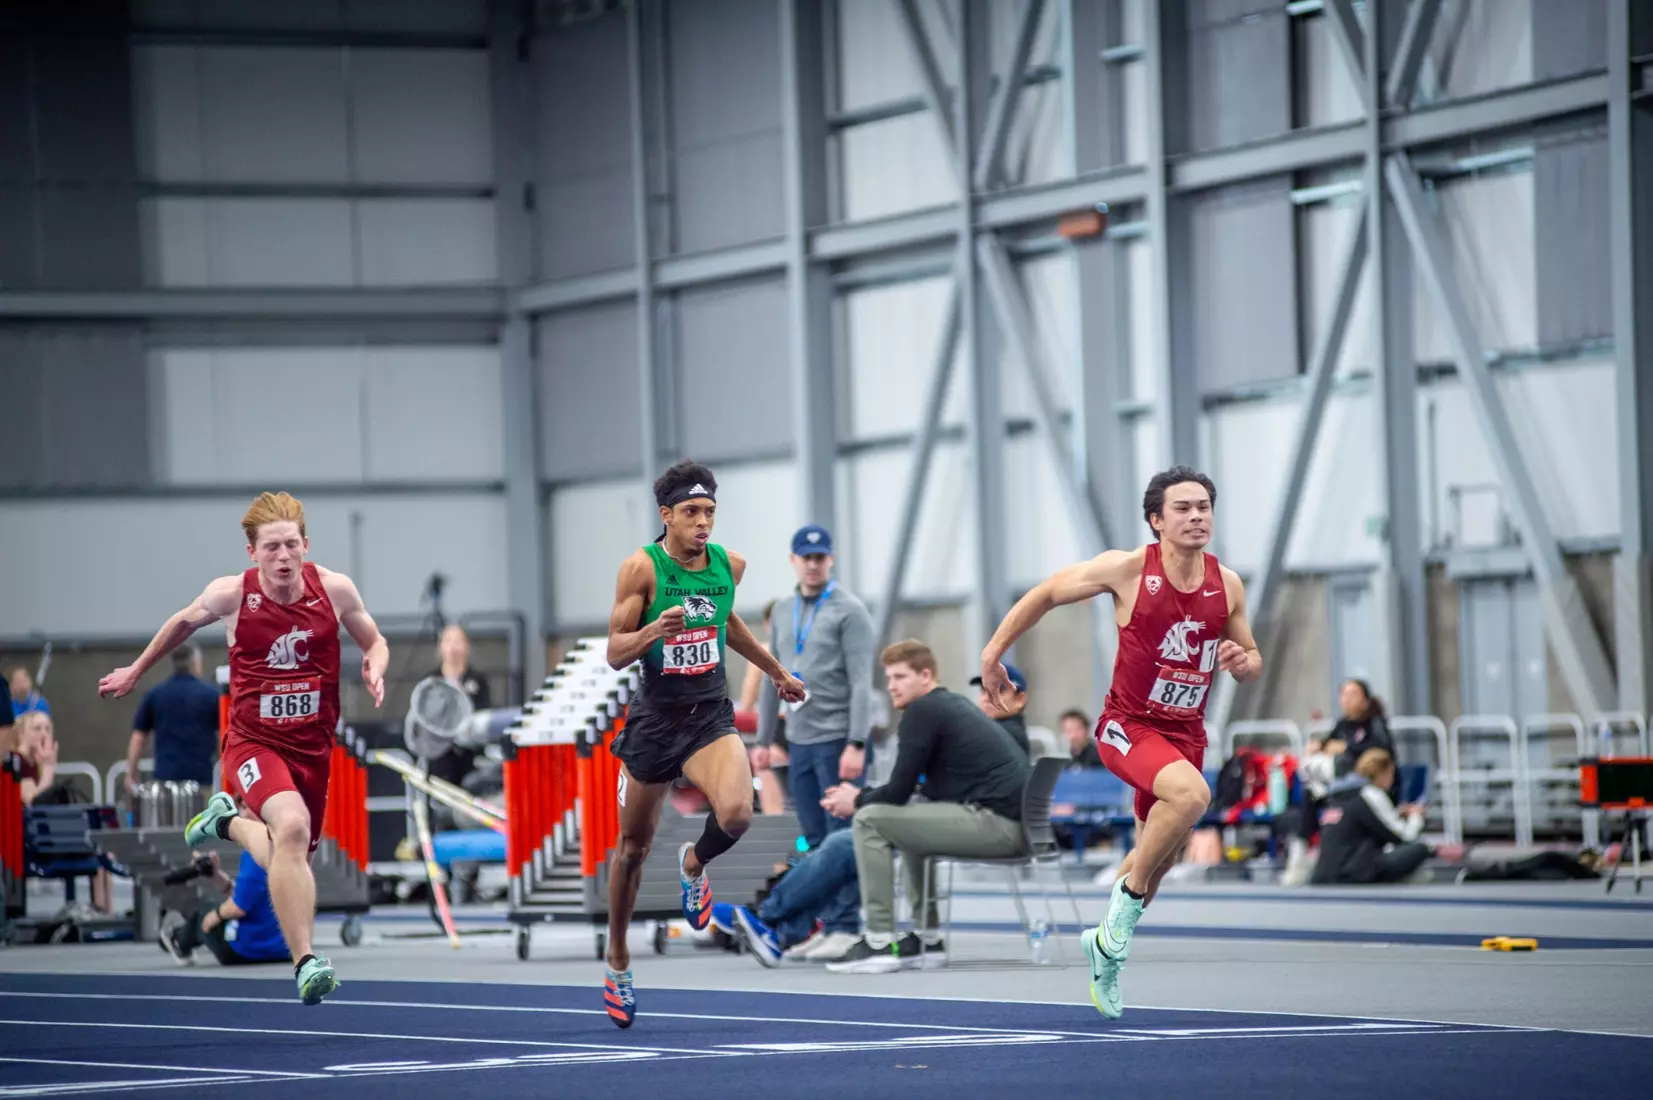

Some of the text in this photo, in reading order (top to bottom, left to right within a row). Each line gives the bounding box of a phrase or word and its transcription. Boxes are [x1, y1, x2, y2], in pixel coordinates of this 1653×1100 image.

[665, 585, 729, 596] UTAH VALLEY
[692, 630, 708, 640] OPEN
[672, 642, 710, 666] 830
[291, 682, 310, 691] OPEN
[1187, 673, 1205, 683] OPEN
[1160, 682, 1201, 707] 875
[271, 694, 311, 717] 868
[1106, 727, 1131, 746] 1
[240, 763, 255, 788] 3
